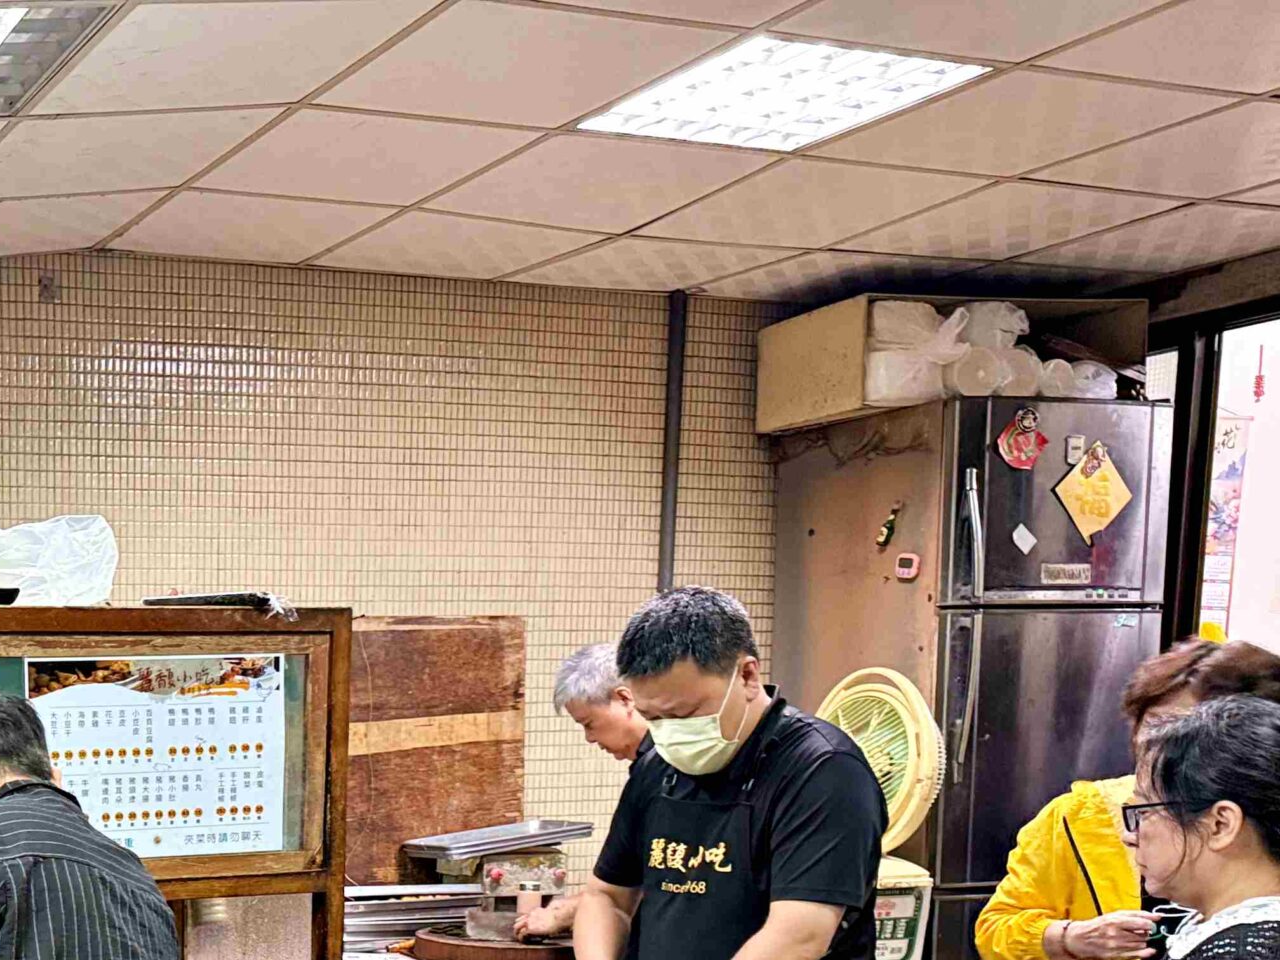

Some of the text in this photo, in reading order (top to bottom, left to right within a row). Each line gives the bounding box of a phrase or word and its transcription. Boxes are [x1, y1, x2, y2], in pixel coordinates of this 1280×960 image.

[64, 712, 72, 737] 小豆干
[648, 838, 732, 873] 麗馥小吃
